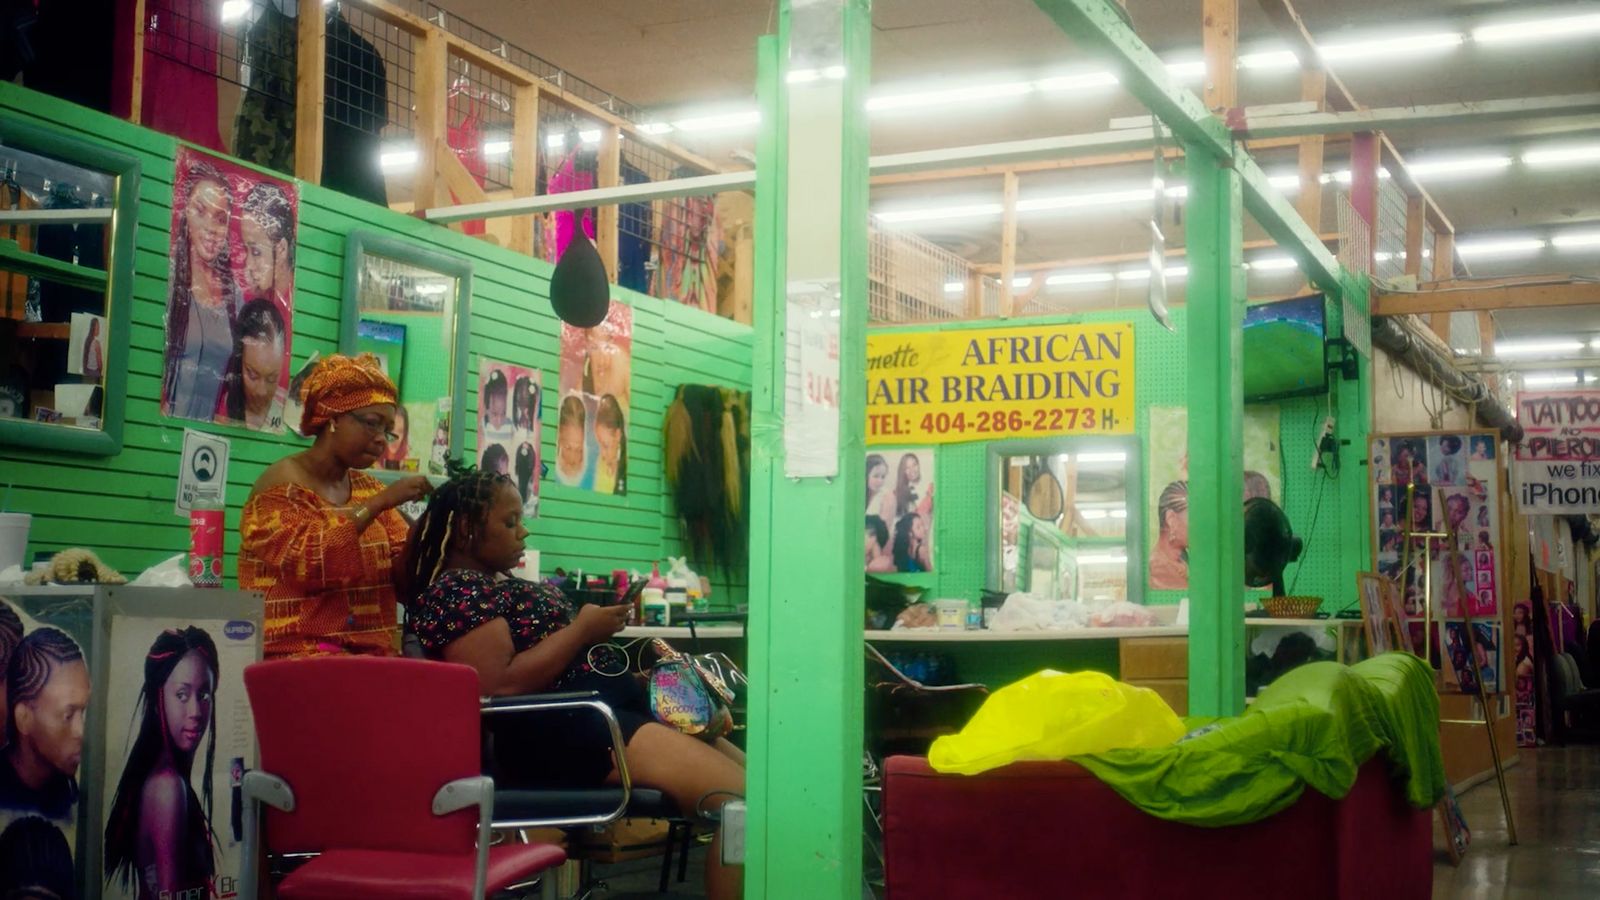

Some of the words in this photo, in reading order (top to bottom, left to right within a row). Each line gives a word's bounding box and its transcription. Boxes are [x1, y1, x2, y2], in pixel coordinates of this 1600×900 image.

[961, 332, 1123, 367] AFRICAN
[942, 369, 1121, 403] BRAIDING
[869, 414, 911, 436] TEL:
[920, 407, 1096, 434] 404-286-2273
[1528, 436, 1600, 457] PIERCI
[1547, 464, 1575, 478] we
[1522, 482, 1600, 505] iPhon
